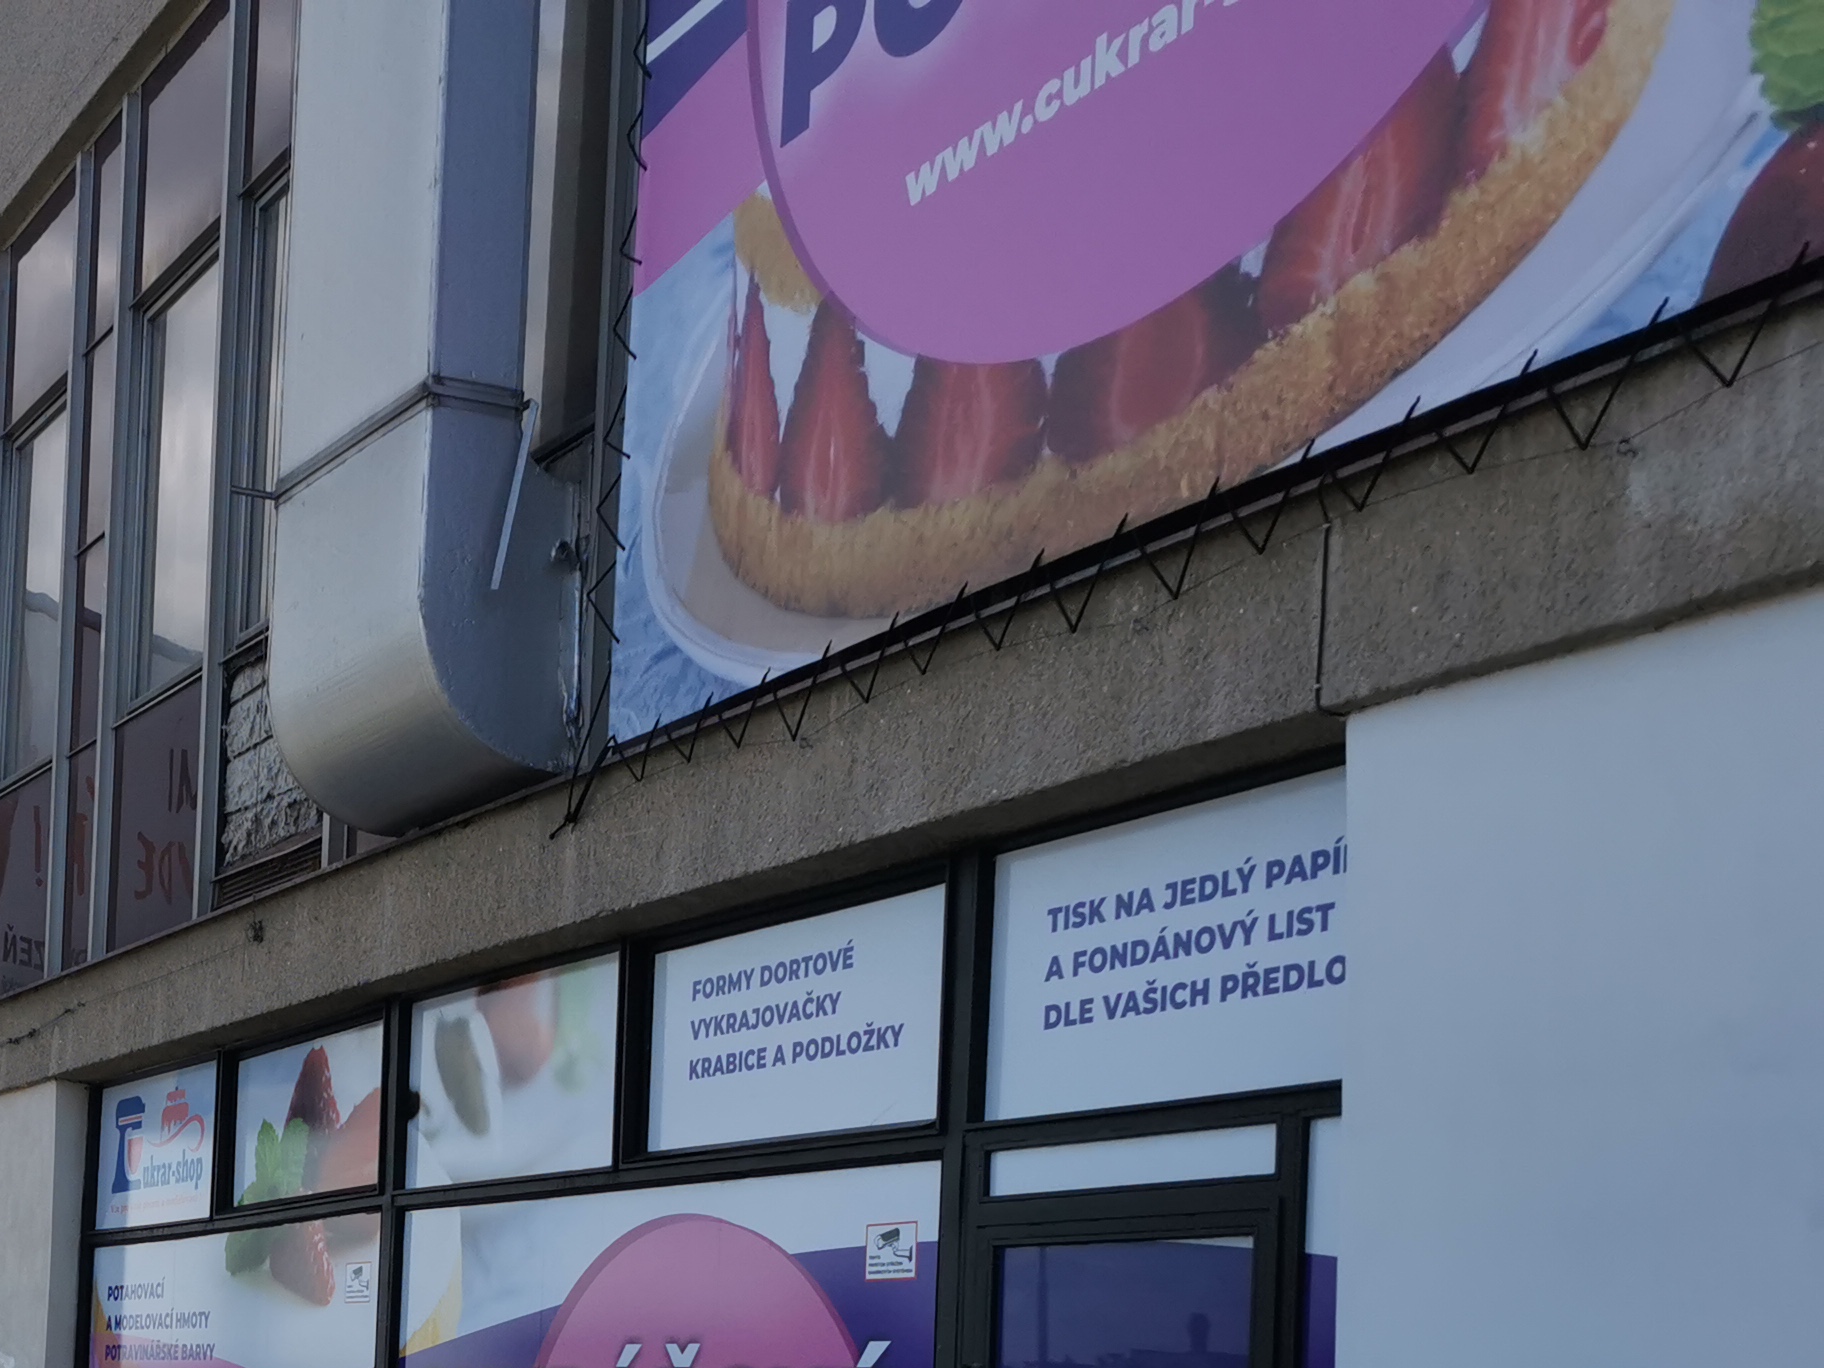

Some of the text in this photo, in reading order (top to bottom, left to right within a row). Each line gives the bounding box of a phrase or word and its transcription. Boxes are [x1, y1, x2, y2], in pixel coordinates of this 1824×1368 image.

[905, 0, 1238, 207] www.cukrar
[1047, 835, 1348, 933] TISK NA JEDLÝ PAPÍ
[691, 938, 854, 1002] FORMY DORTOVÉ
[1044, 901, 1336, 983] A FONDÁNOVÝ LIST
[690, 990, 842, 1041] VYKRAJOVAČKY
[1043, 954, 1347, 1030] DLE VAŠICH PŘEDLO
[688, 1022, 904, 1081] KRABICE A PODLOŽKY
[106, 1307, 211, 1331] A MODELOVACÍ HMOTY
[107, 1276, 165, 1301] POTAHOVACÍ
[105, 1339, 215, 1361] POTRAVINÁŘSKÉ BARVY
